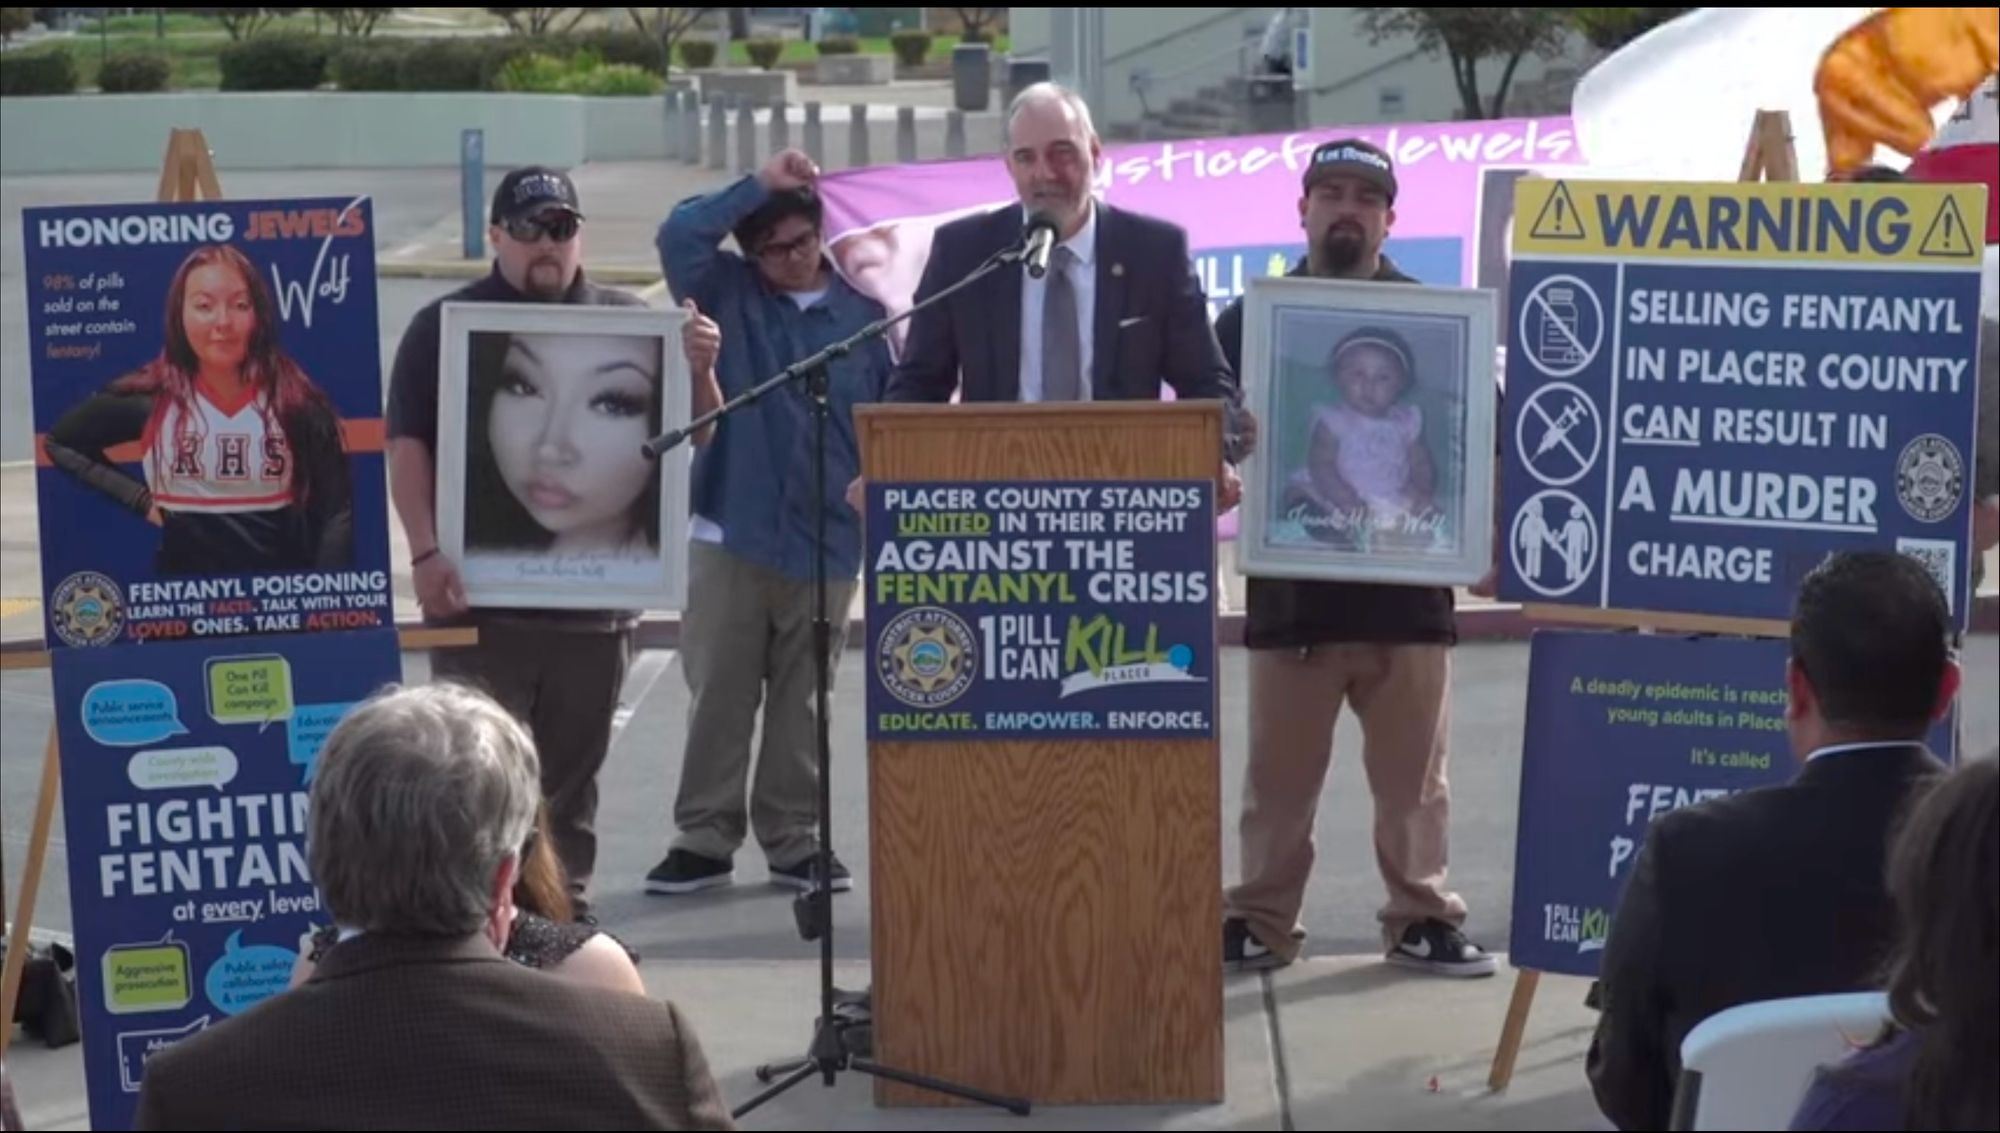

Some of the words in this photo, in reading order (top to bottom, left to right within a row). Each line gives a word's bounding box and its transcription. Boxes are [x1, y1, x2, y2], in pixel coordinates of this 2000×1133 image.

[39, 213, 233, 247] HONORING
[243, 207, 365, 241] JEWELS
[1595, 193, 1912, 255] WARNING
[79, 273, 95, 290] of
[97, 272, 124, 293] pills
[44, 298, 71, 313] sold
[77, 301, 94, 312] on
[98, 297, 119, 312] the
[1628, 289, 1769, 328] SELLING
[1782, 295, 1963, 334] FENTANYL
[45, 321, 82, 336] street
[86, 318, 136, 335] contain
[46, 341, 101, 360] fentanyl
[1626, 347, 1666, 381] IN
[1678, 351, 1806, 388] PLACER
[1818, 355, 1968, 393] COUNTY
[1622, 404, 1700, 446] CAN
[1712, 409, 1836, 448] RESULT
[1846, 414, 1888, 450] IN
[885, 489, 976, 509] PLACER
[985, 488, 1092, 509] COUNTY
[1101, 488, 1201, 509] STANDS
[1618, 465, 1656, 512] A
[1670, 468, 1878, 533] MURDER
[898, 512, 991, 537] UNITED
[999, 512, 1027, 532] IN
[1036, 512, 1104, 532] THEIR
[1114, 512, 1187, 532] FIGHT
[875, 540, 1052, 571] AGAINST
[1065, 540, 1134, 570] THE
[1628, 541, 1773, 583] CHARGE
[129, 579, 246, 603] FENTANYL
[252, 571, 386, 596] POISONING
[877, 573, 1076, 603] FENTANYL
[1088, 572, 1208, 602] CRISIS
[127, 603, 175, 619] LEARN
[178, 601, 205, 616] THE
[208, 600, 258, 615] FACTS.
[262, 598, 297, 612] TALK
[302, 596, 340, 610] WITH
[344, 593, 387, 608] YOUR
[127, 621, 187, 639] LOVED
[192, 617, 249, 637] ONES.
[255, 613, 300, 632] TAKE
[306, 610, 382, 629] ACTION.
[1000, 614, 1060, 646] PILL
[979, 615, 996, 680] 1
[1065, 613, 1170, 678] KILL
[226, 671, 248, 682] One
[252, 668, 268, 681] Pill
[1000, 648, 1060, 680] CAN
[1104, 666, 1150, 681] PLACER
[227, 683, 249, 697] Can
[252, 682, 270, 695] Kill
[1570, 677, 1584, 694] A
[1587, 678, 1641, 699] deadly
[1645, 683, 1720, 704] epidemic
[1724, 685, 1738, 703] is
[91, 702, 123, 715] Public
[128, 700, 164, 712] service
[224, 697, 278, 711] campaign
[88, 710, 172, 727] announcements
[879, 713, 978, 731] EDUCATE.
[985, 712, 1100, 730] EMPOWER.
[1107, 711, 1209, 730] ENFORCE.
[1607, 706, 1658, 727] young
[1662, 707, 1713, 727] adults
[1717, 710, 1734, 728] in
[1691, 746, 1715, 765] It's
[1720, 750, 1771, 769] called
[173, 903, 195, 921] at
[202, 899, 264, 923] every
[270, 887, 320, 914] level
[1553, 904, 1581, 924] PILL
[1544, 904, 1553, 940] 1
[1552, 924, 1579, 943] CAN
[116, 963, 176, 979] Aggressive
[225, 960, 256, 974] Public
[115, 977, 179, 993] prosecution
